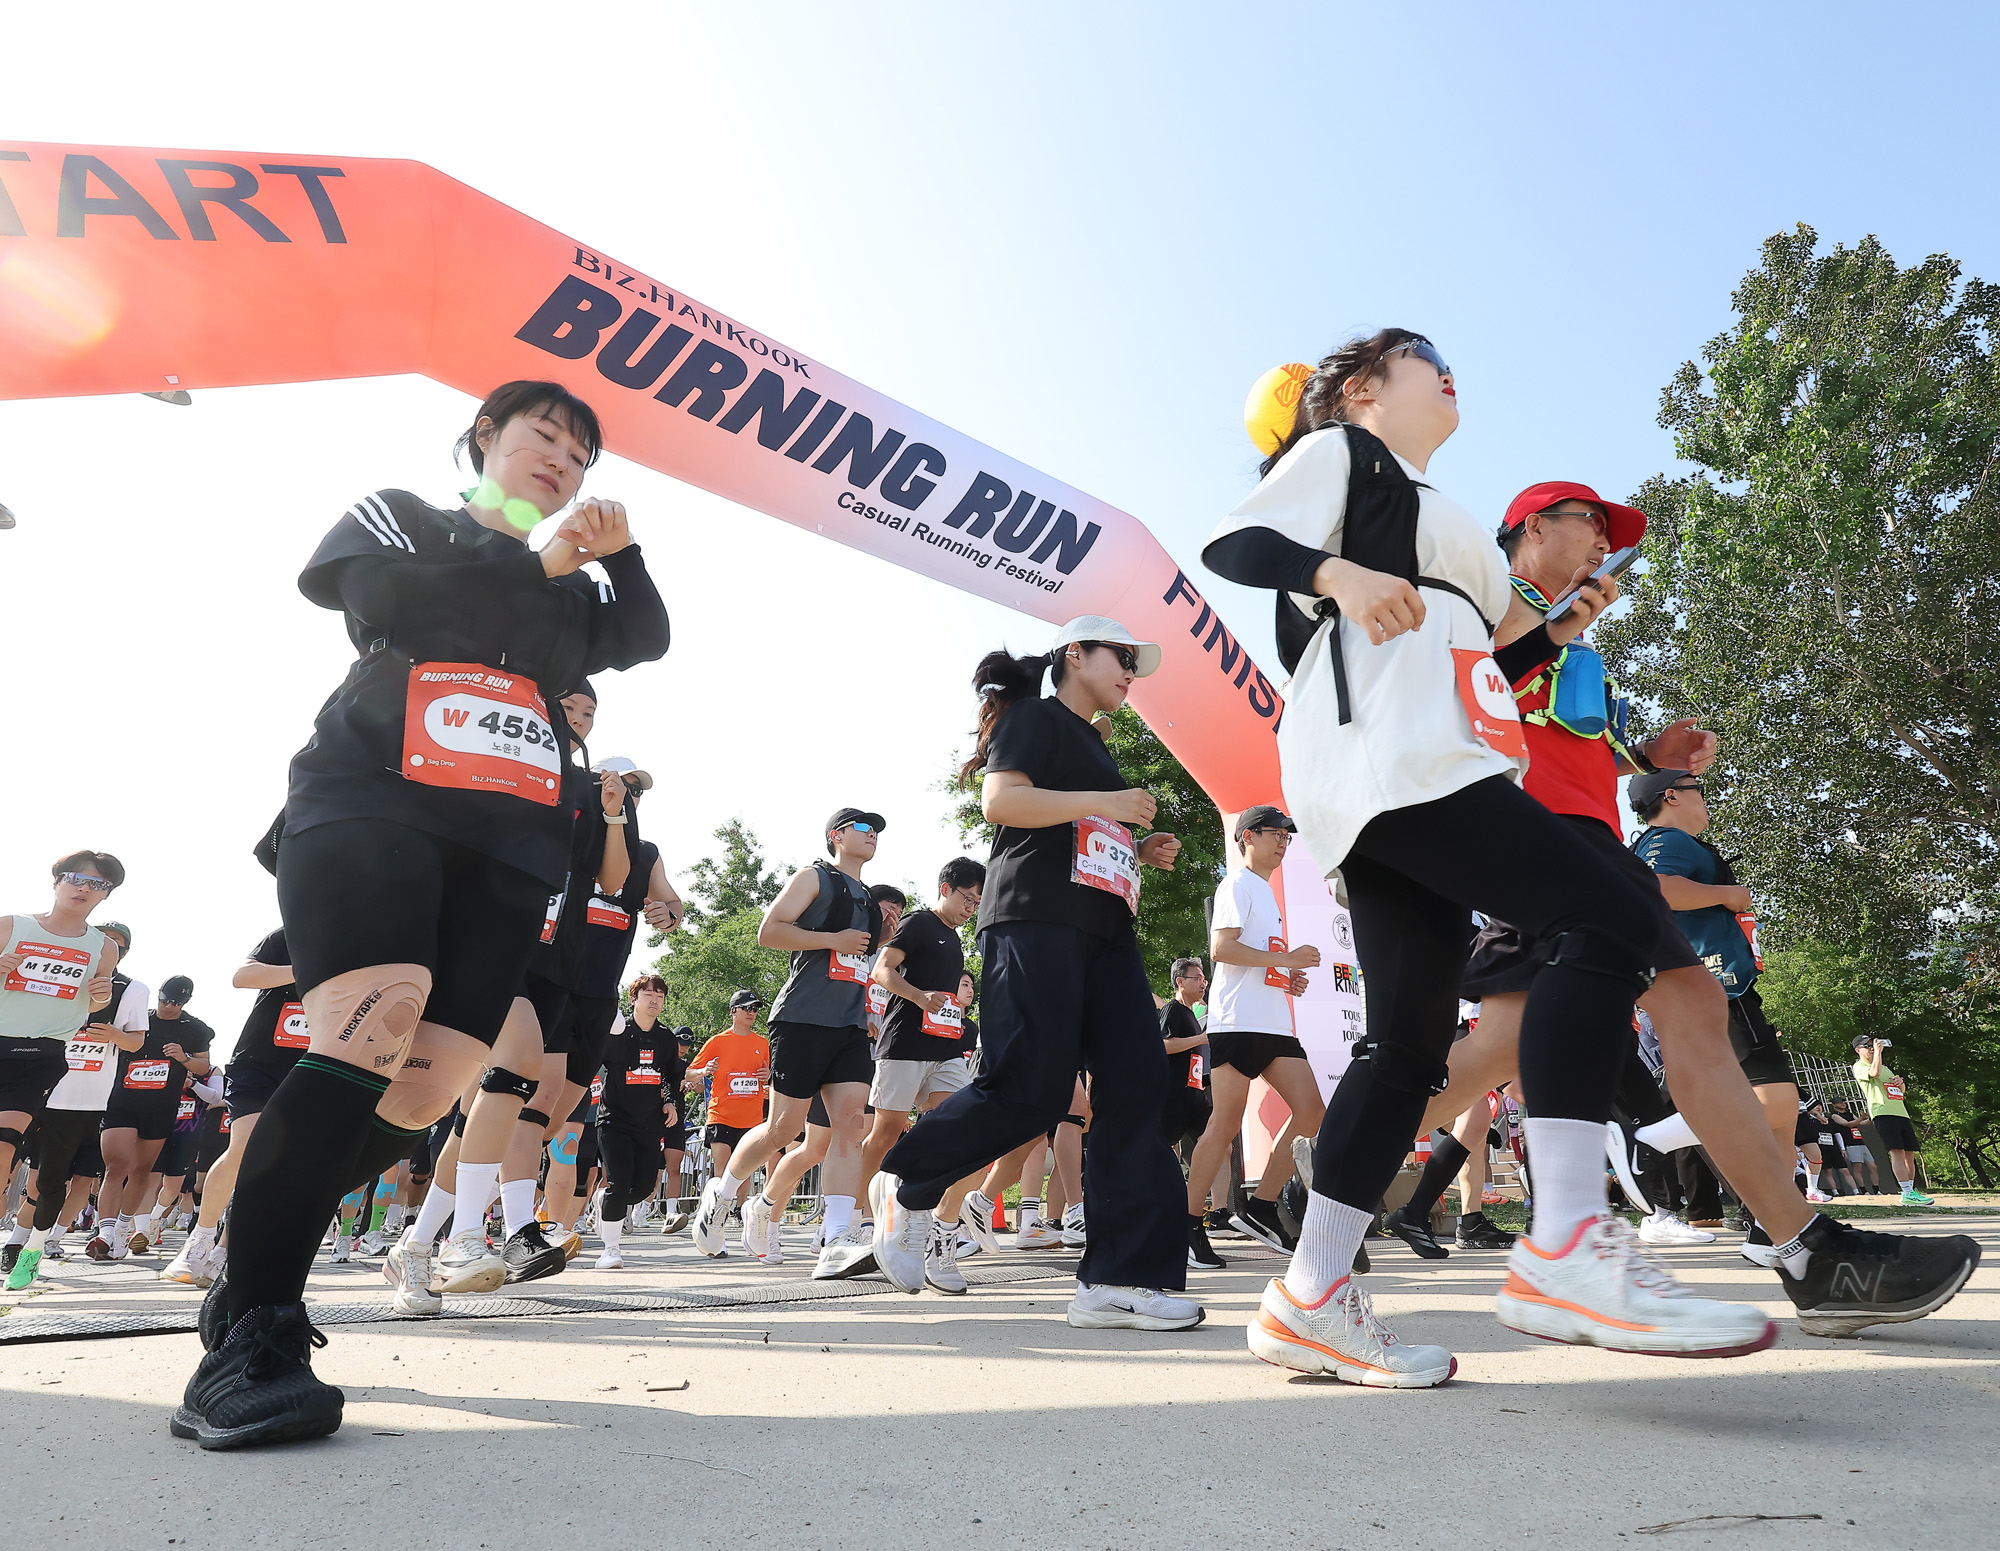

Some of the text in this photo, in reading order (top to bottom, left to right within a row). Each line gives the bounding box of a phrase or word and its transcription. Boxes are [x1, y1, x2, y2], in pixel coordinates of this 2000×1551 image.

[514, 274, 1102, 575] BURNING RUN
[837, 491, 1065, 594] Casual Running Festival
[1162, 569, 1285, 734] FINIS
[419, 672, 514, 690] BURNING RUN
[1485, 674, 1504, 693] W
[443, 707, 470, 728] W
[478, 711, 556, 752] 4552
[491, 741, 521, 757] 노윤경
[427, 758, 456, 768] Bag Drop
[1085, 815, 1121, 835] URNING RUN
[1094, 840, 1107, 854] W
[1081, 859, 1108, 875] C-182
[21, 944, 51, 953] BURNING
[50, 948, 65, 956] RUN
[25, 961, 38, 971] M
[42, 963, 83, 979] 1846
[30, 983, 52, 993] B-232
[1335, 978, 1360, 996] KIND
[338, 994, 380, 1042] ROCKTAPE
[939, 1006, 960, 1020] 2520
[1342, 1009, 1361, 1023] TOUS
[289, 1019, 301, 1028] M
[1342, 1030, 1363, 1043] JOU
[69, 1044, 104, 1055] 2174
